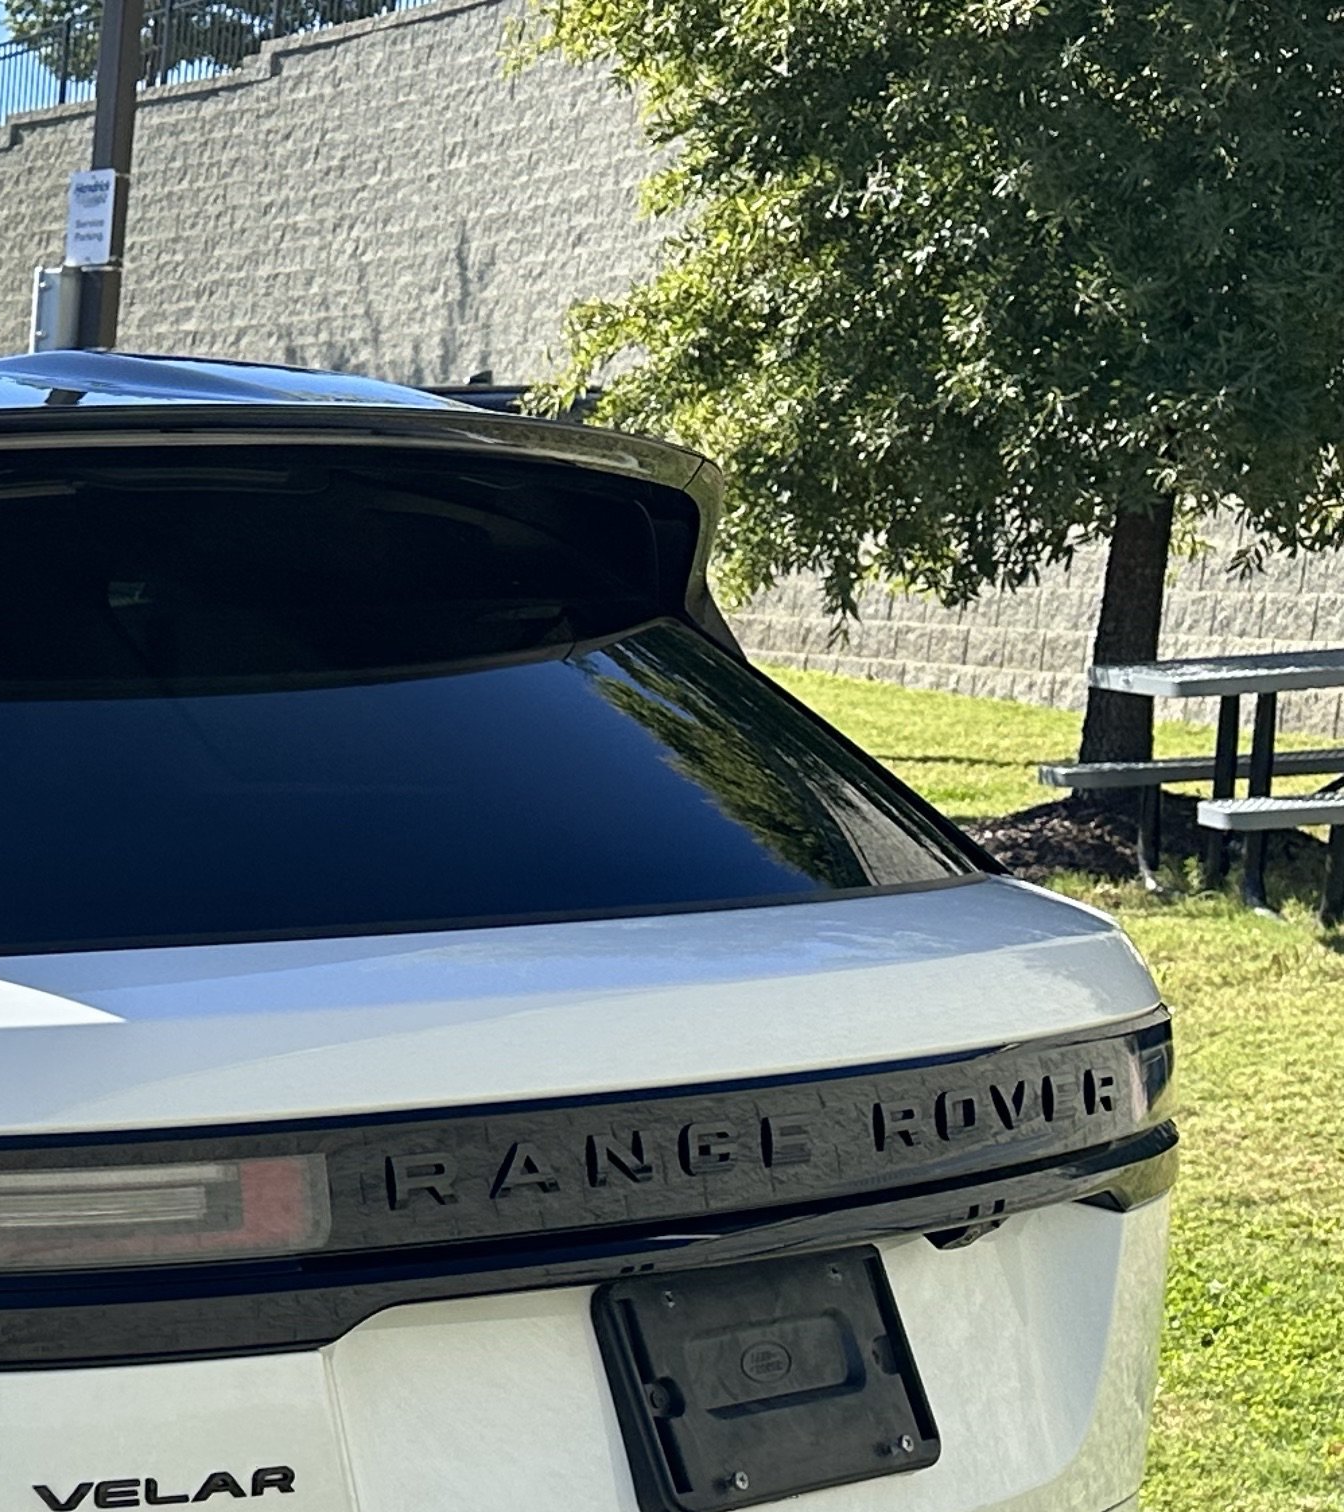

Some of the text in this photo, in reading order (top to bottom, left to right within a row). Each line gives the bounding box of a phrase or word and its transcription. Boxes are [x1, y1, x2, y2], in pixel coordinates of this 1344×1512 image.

[384, 1068, 1115, 1211] RANGE ROVER
[31, 1465, 296, 1512] VELAR
